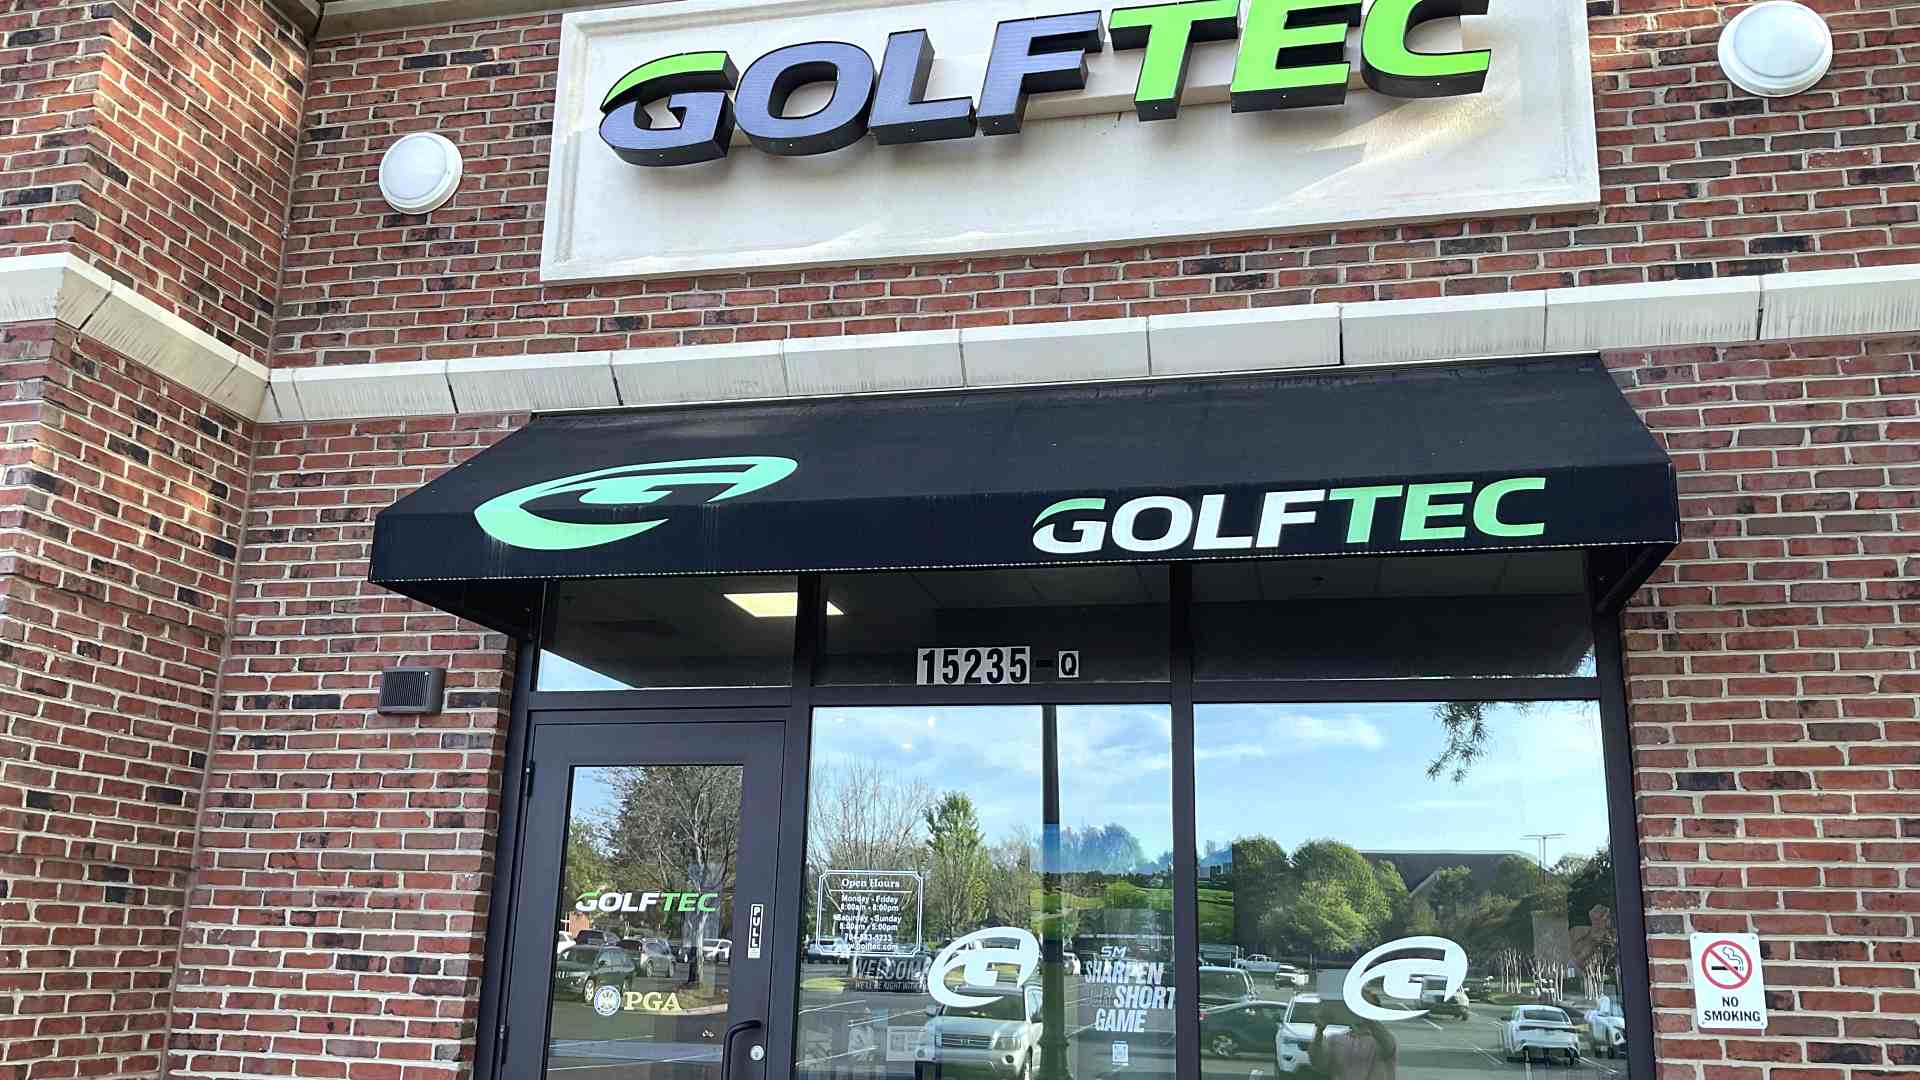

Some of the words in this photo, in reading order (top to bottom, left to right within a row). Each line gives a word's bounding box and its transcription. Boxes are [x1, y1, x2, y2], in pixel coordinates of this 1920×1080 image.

[598, 0, 1491, 164] GOLFTEC
[1033, 477, 1546, 554] GOLFTEC
[842, 878, 867, 888] Open
[870, 878, 900, 888] Hours
[575, 891, 719, 912] GOLFTEC
[841, 894, 869, 904] Monday
[876, 895, 898, 905] Friday
[752, 906, 761, 947] PULL
[836, 913, 868, 924] Saturday
[874, 914, 902, 924] Sunday
[1085, 961, 1164, 984] SHARPEN
[623, 991, 682, 1011] PGA
[1114, 985, 1176, 1009] SHORT
[1721, 996, 1739, 1008] NO
[1096, 1008, 1147, 1032] GAME
[1703, 1010, 1761, 1022] SMOKING
